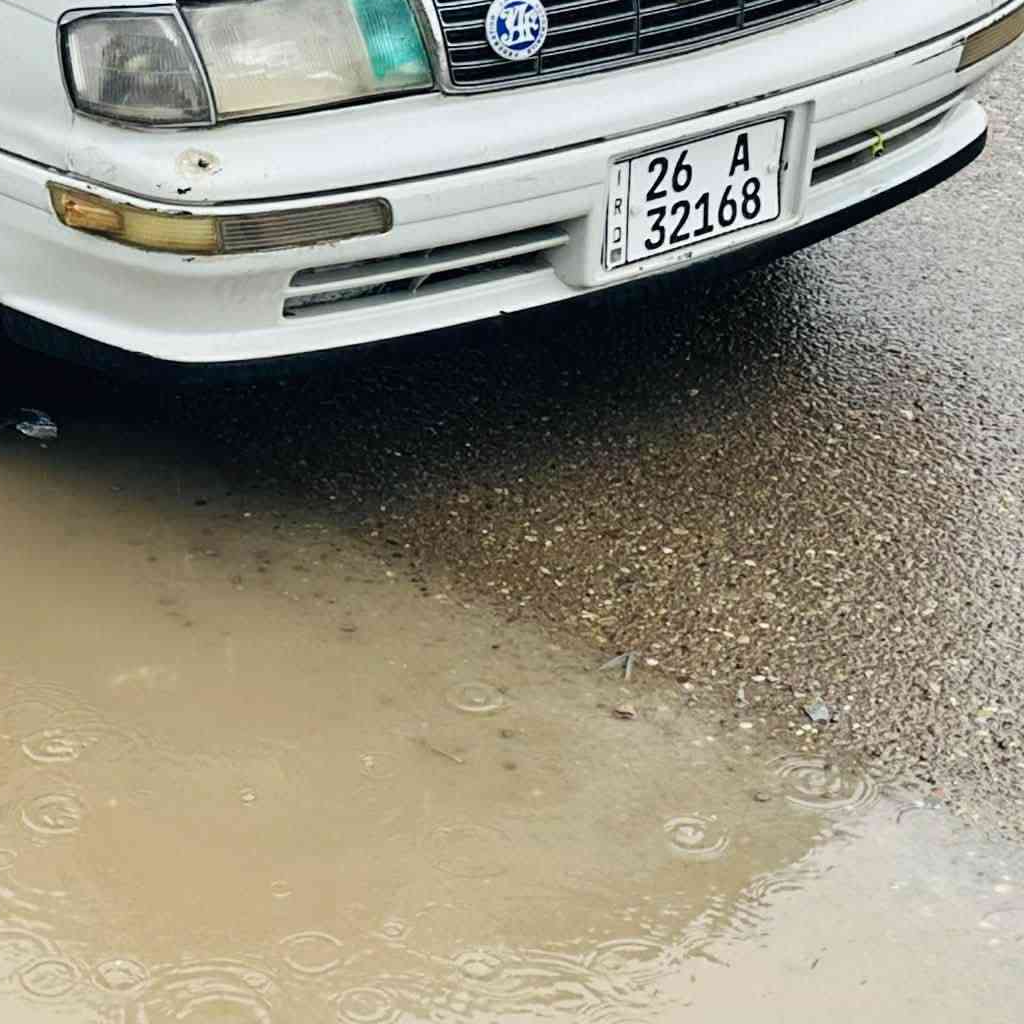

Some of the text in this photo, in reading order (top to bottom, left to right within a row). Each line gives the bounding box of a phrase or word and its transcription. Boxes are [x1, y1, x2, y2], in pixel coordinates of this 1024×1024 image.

[645, 132, 750, 202] 26 A
[643, 176, 762, 251] 32168
